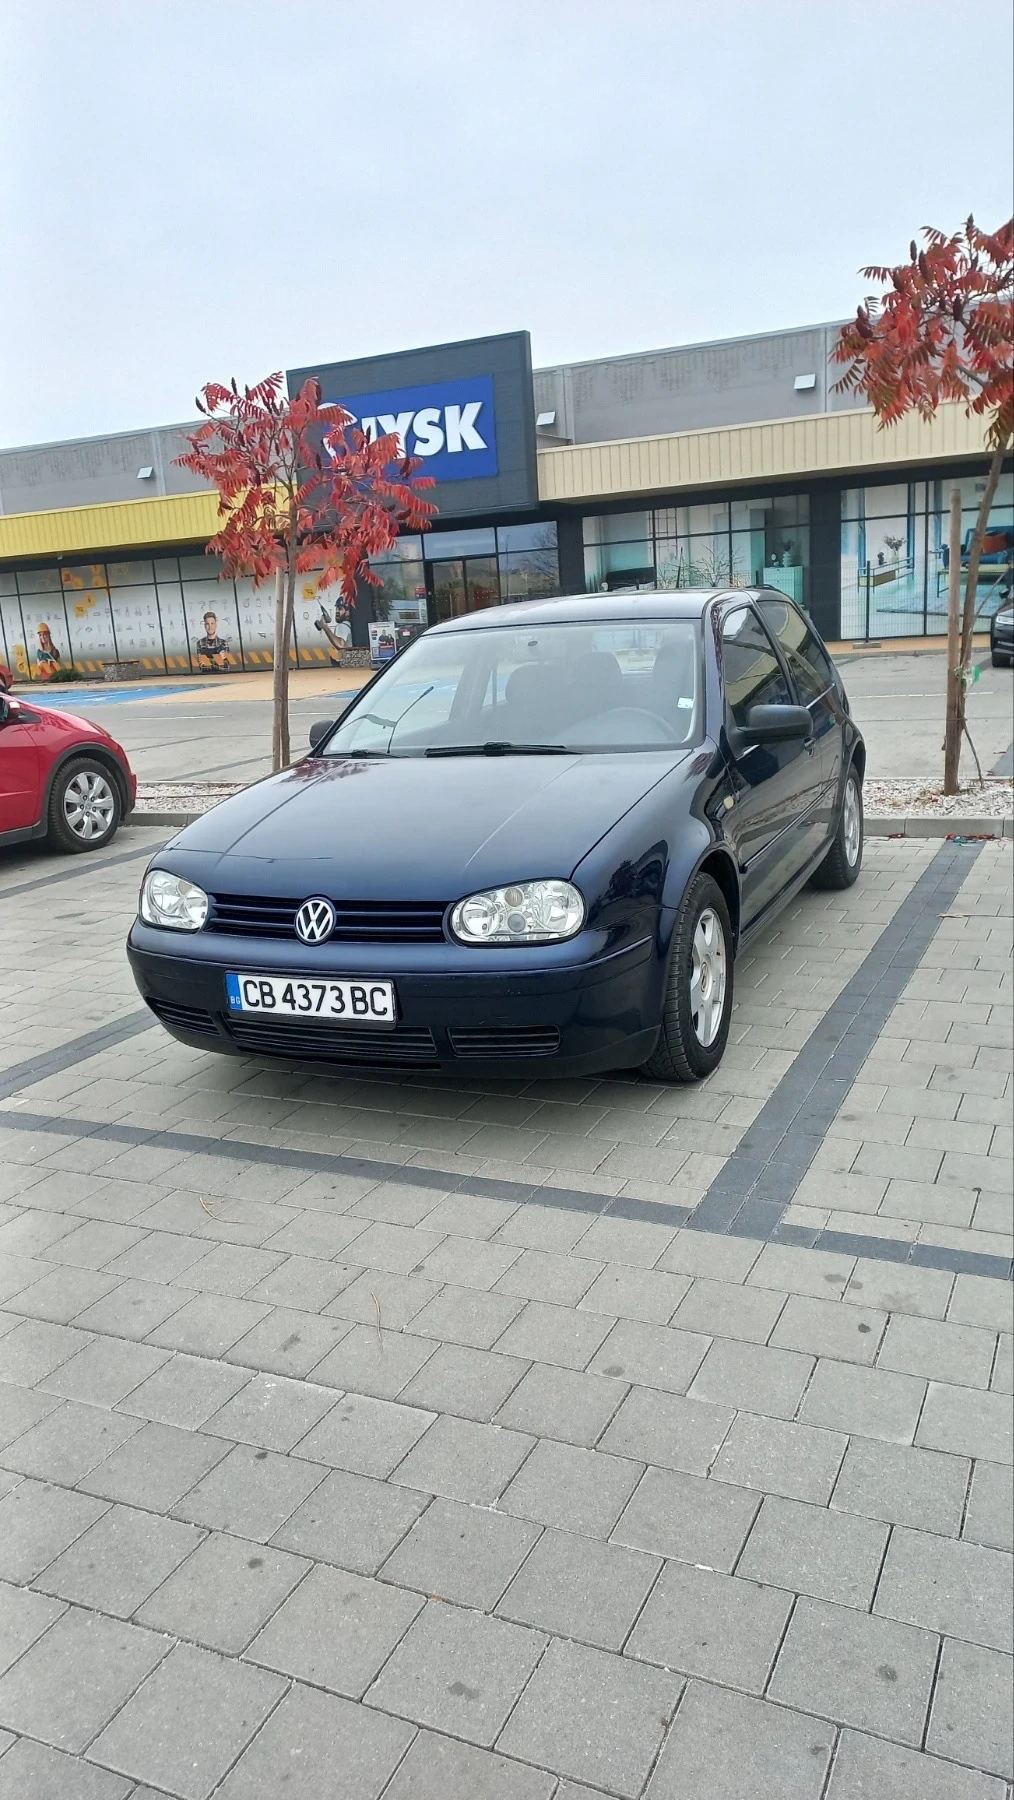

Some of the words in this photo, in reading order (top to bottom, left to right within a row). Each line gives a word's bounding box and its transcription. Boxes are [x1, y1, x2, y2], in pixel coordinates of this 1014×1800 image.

[243, 979, 277, 1009] CB
[281, 983, 346, 1014] 4373
[350, 986, 388, 1016] BC
